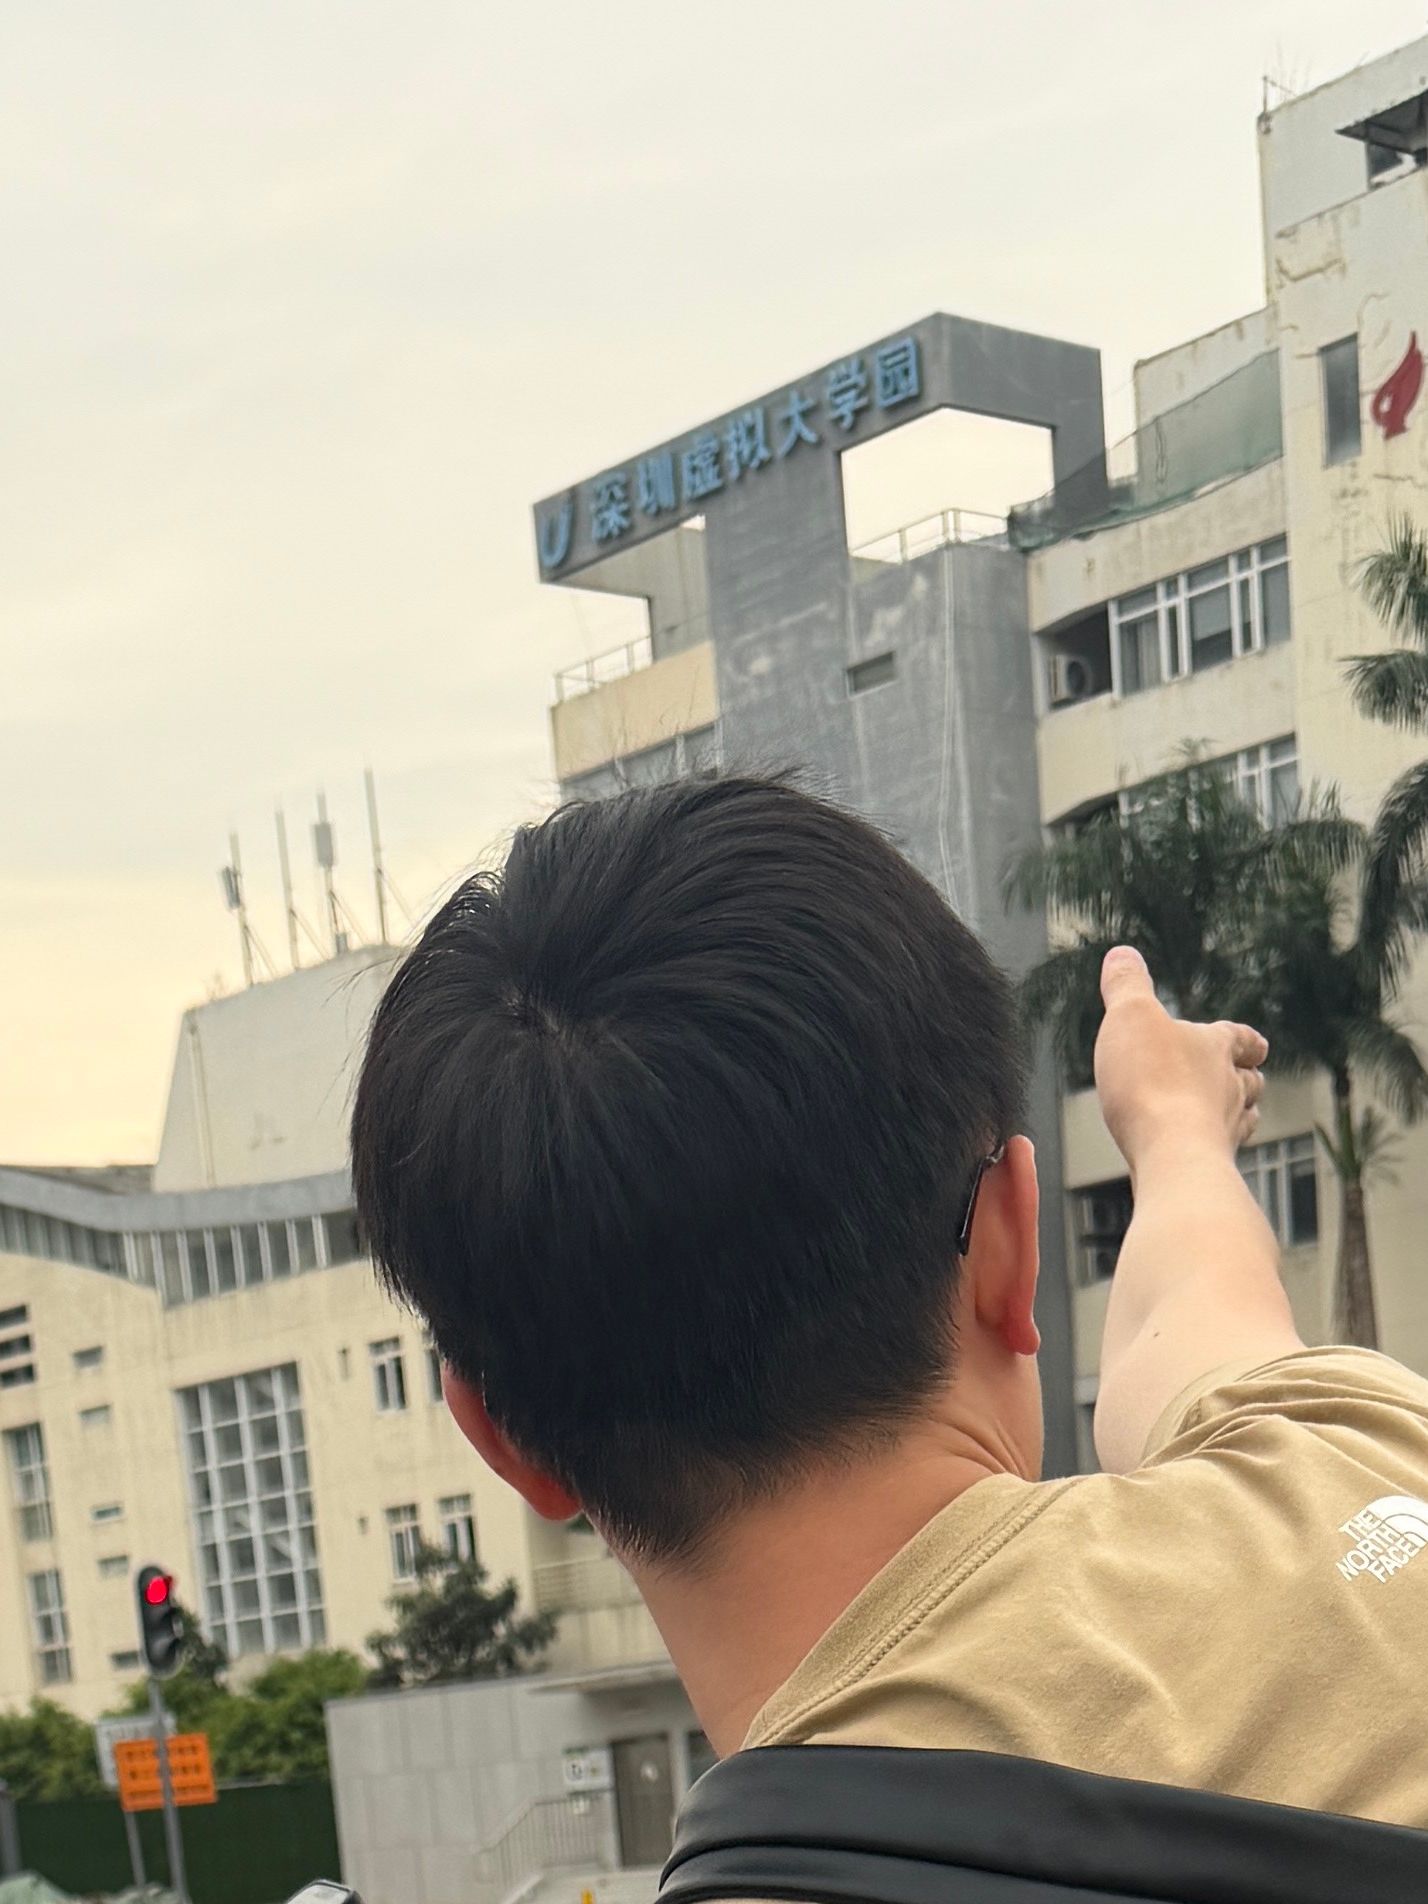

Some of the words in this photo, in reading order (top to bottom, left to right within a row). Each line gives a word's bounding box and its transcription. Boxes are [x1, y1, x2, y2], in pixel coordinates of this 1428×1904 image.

[589, 336, 921, 544] 深圳虚拟大学园
[1338, 1508, 1382, 1542] THE
[1335, 1524, 1401, 1582] NORTH
[1367, 1536, 1421, 1583] FACE
